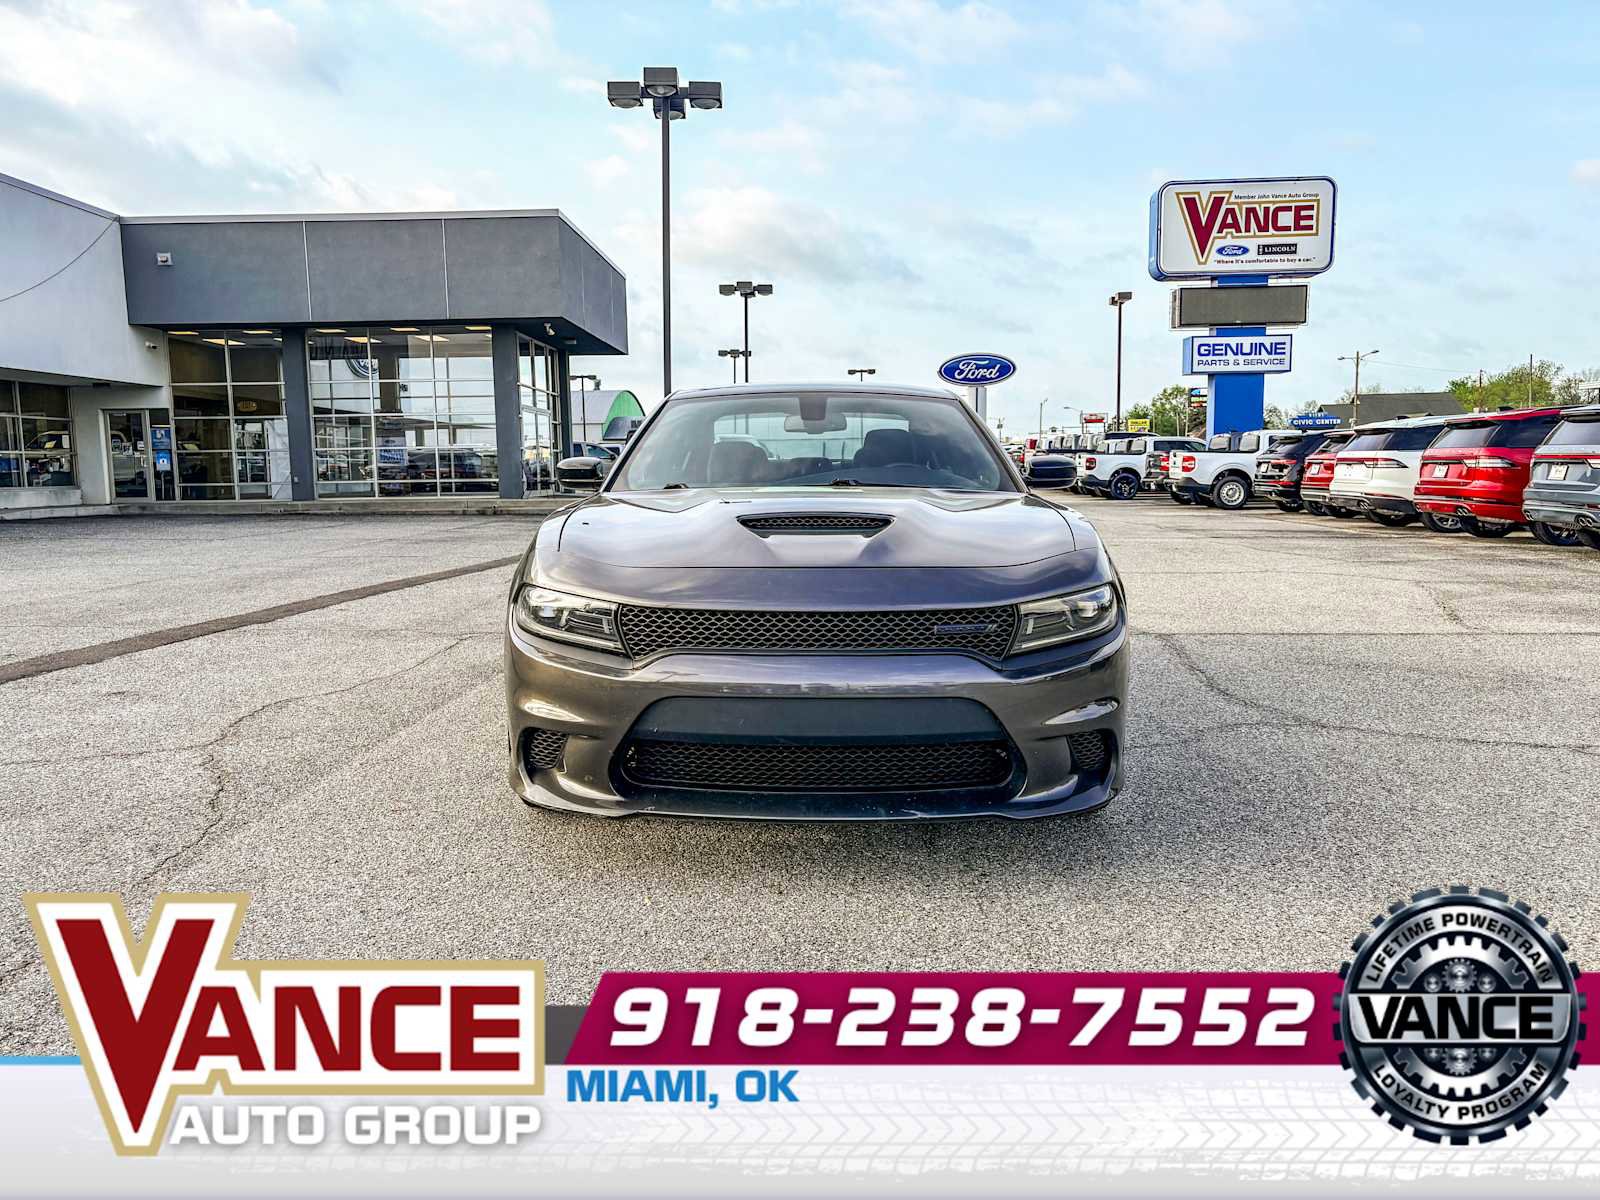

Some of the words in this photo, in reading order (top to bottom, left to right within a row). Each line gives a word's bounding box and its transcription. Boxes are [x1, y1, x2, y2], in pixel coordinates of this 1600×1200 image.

[1182, 197, 1315, 258] VANCE
[1264, 244, 1296, 253] LINCOLN
[1197, 342, 1286, 356] GENUINE
[1232, 358, 1240, 366] &
[1243, 358, 1285, 366] SERVICE
[954, 360, 1001, 379] Ford
